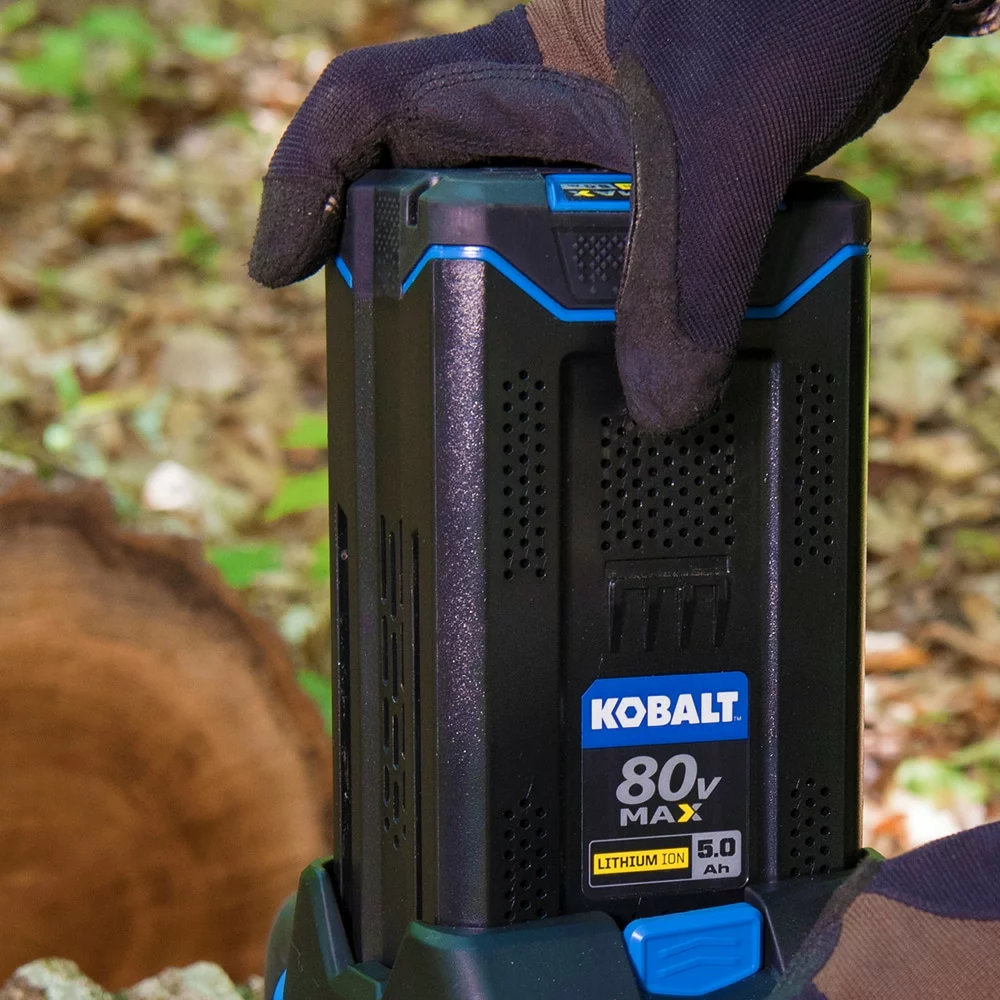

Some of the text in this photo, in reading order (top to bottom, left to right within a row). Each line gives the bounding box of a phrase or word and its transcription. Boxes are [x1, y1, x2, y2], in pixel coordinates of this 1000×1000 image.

[591, 691, 739, 730] KOBALT
[620, 802, 703, 826] MAX
[697, 837, 736, 858] 5.0
[597, 852, 685, 870] LITHIUM ION
[703, 863, 730, 875] Ah
